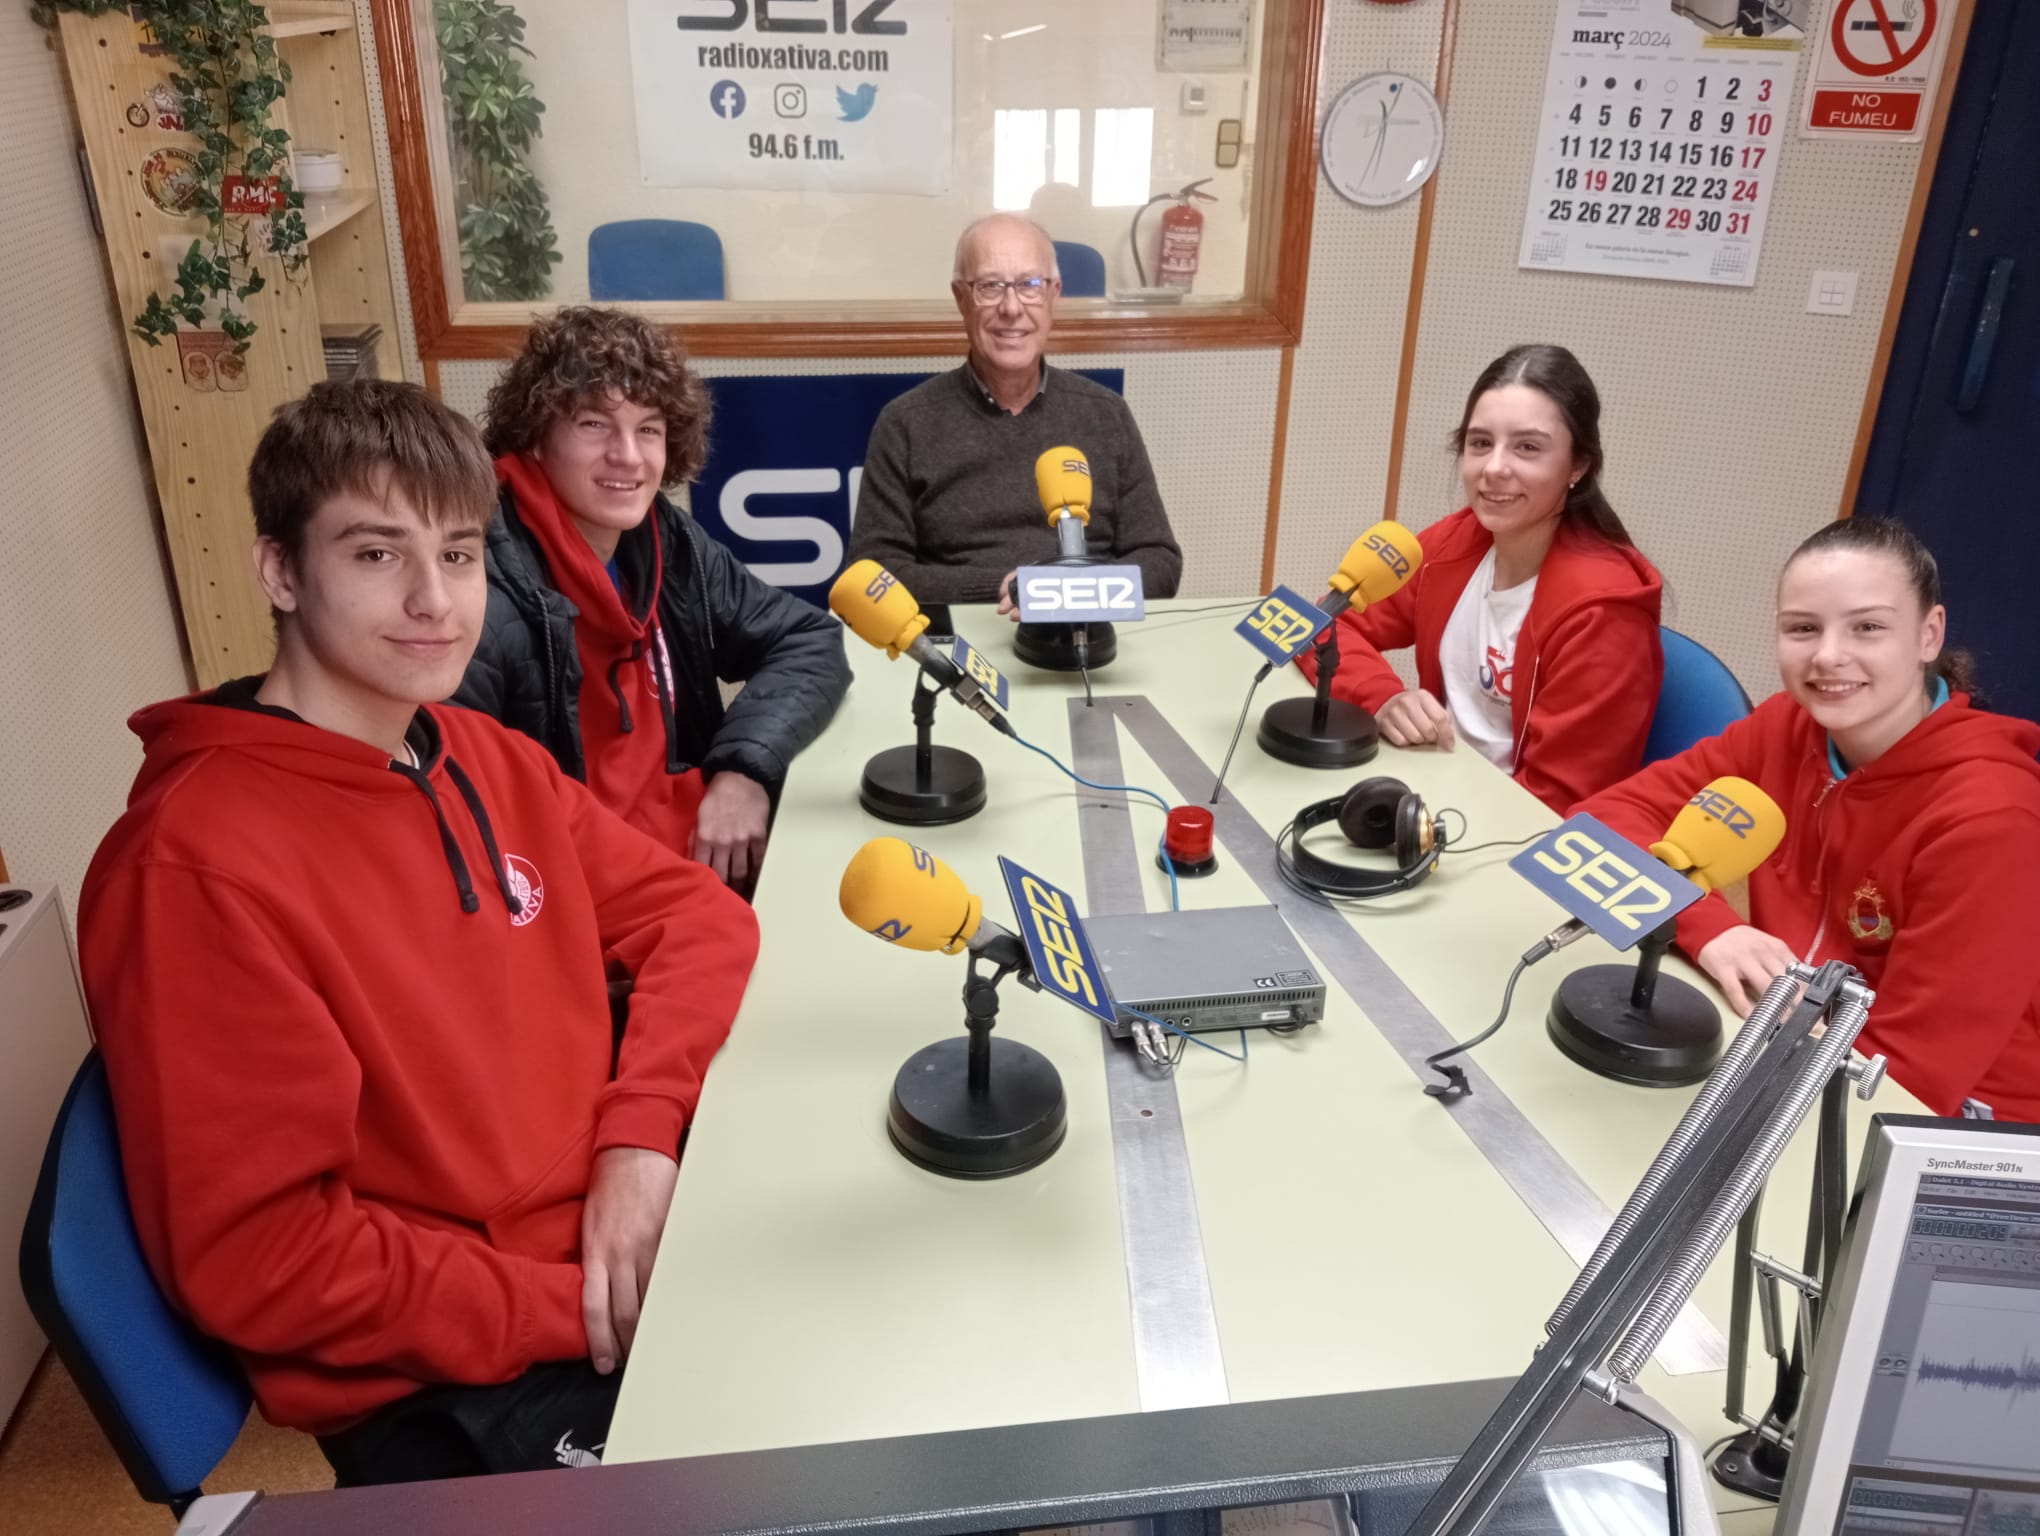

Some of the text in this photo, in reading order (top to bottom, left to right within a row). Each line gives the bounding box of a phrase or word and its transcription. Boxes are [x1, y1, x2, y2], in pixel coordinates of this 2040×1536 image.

[1572, 29, 1672, 50] març 2024
[698, 43, 889, 72] radioxativa.com
[1697, 76, 1772, 102] 1 2 3
[1851, 93, 1881, 108] NO
[1569, 103, 1772, 136] 4 5 6 7 8 9 10
[1829, 111, 1897, 127] FUMEU
[749, 133, 845, 161] 94.6 f.m.
[1560, 135, 1766, 169] 11 12 13 14 15 16 17
[1555, 167, 1759, 202] 18 19 20 21 22 23 24
[1548, 199, 1750, 235] 25 26 27 28 29 30 31
[1362, 533, 1411, 580] SER
[1026, 577, 1137, 611] SER
[1246, 597, 1315, 654] SER
[1688, 788, 1756, 840] SER
[1533, 830, 1672, 931] SER
[1021, 876, 1099, 1007] SER
[1927, 1158, 1994, 1172] SyncMaster
